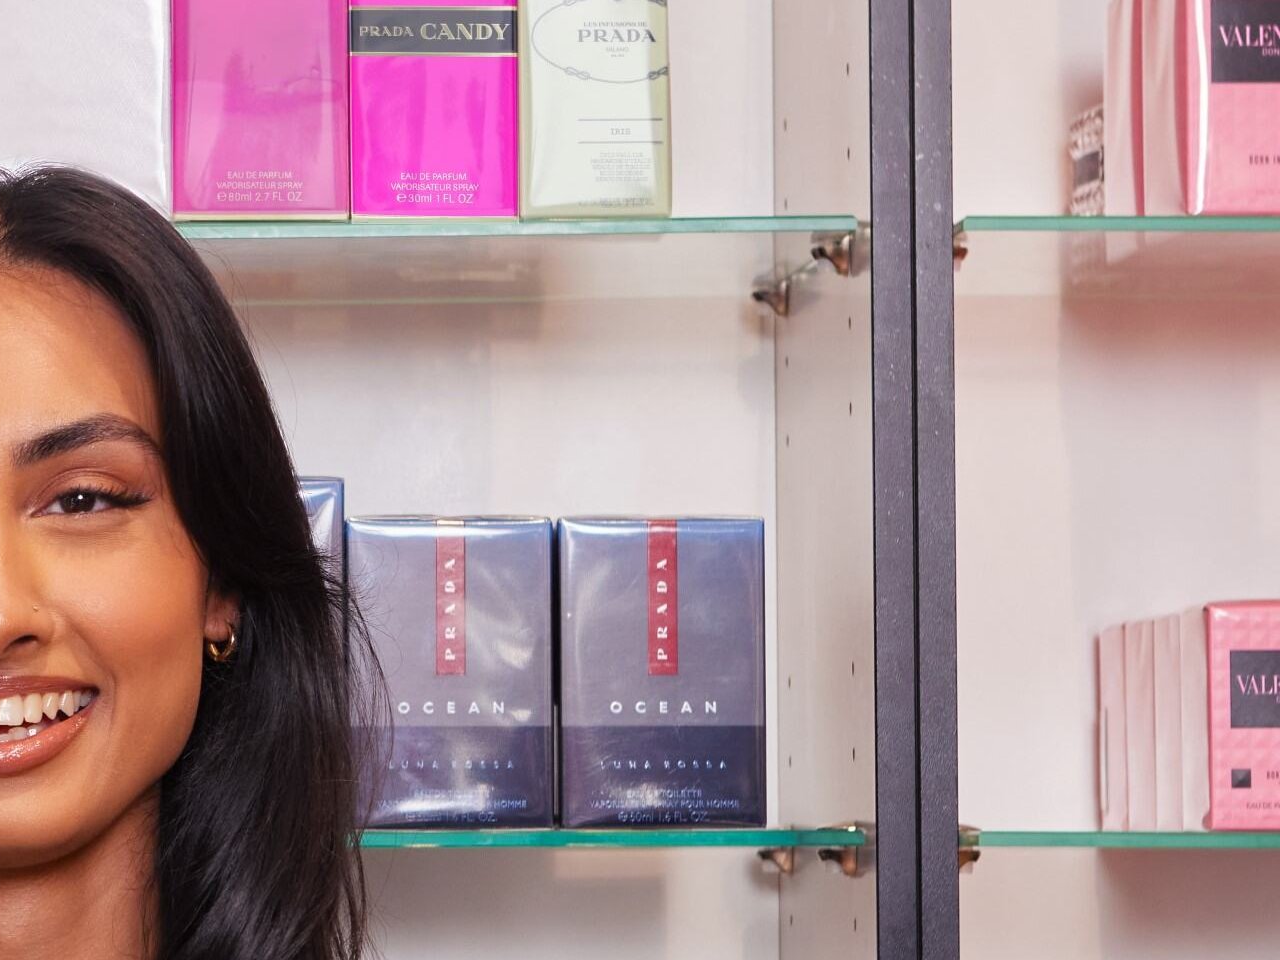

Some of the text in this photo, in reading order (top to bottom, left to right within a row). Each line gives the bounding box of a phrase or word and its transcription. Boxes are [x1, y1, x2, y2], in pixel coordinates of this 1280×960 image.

[359, 22, 512, 41] PRADA CANDY
[577, 28, 657, 43] PRADA
[400, 172, 467, 180] EAU DE PARFUM
[453, 183, 480, 191] SPRAY
[443, 194, 455, 203] FL
[458, 194, 474, 203] OZ
[444, 558, 456, 661] PRADA
[657, 558, 668, 660] PRADA
[398, 701, 505, 714] OCEAN
[609, 701, 718, 714] OCEAN
[388, 760, 439, 769] LUNA
